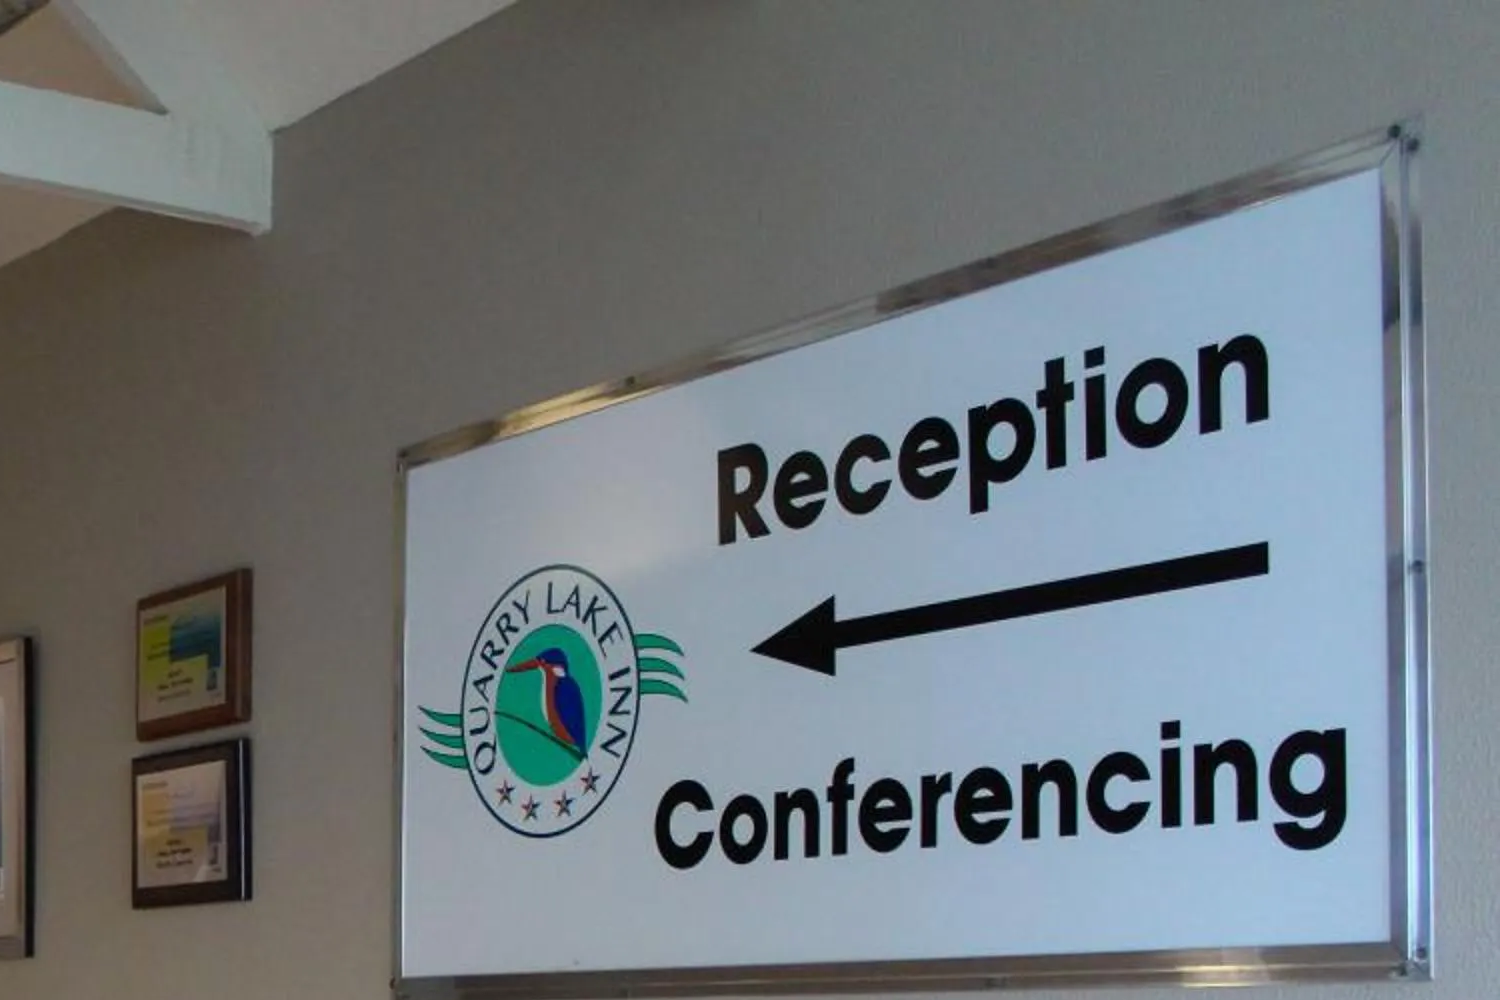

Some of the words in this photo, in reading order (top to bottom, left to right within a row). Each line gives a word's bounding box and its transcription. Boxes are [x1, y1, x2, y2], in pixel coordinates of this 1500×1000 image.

[717, 334, 1270, 546] Reception
[468, 588, 531, 777] QUARRY
[546, 581, 624, 658] LAKE
[600, 666, 632, 758] INN
[654, 720, 1347, 870] Conferencing
